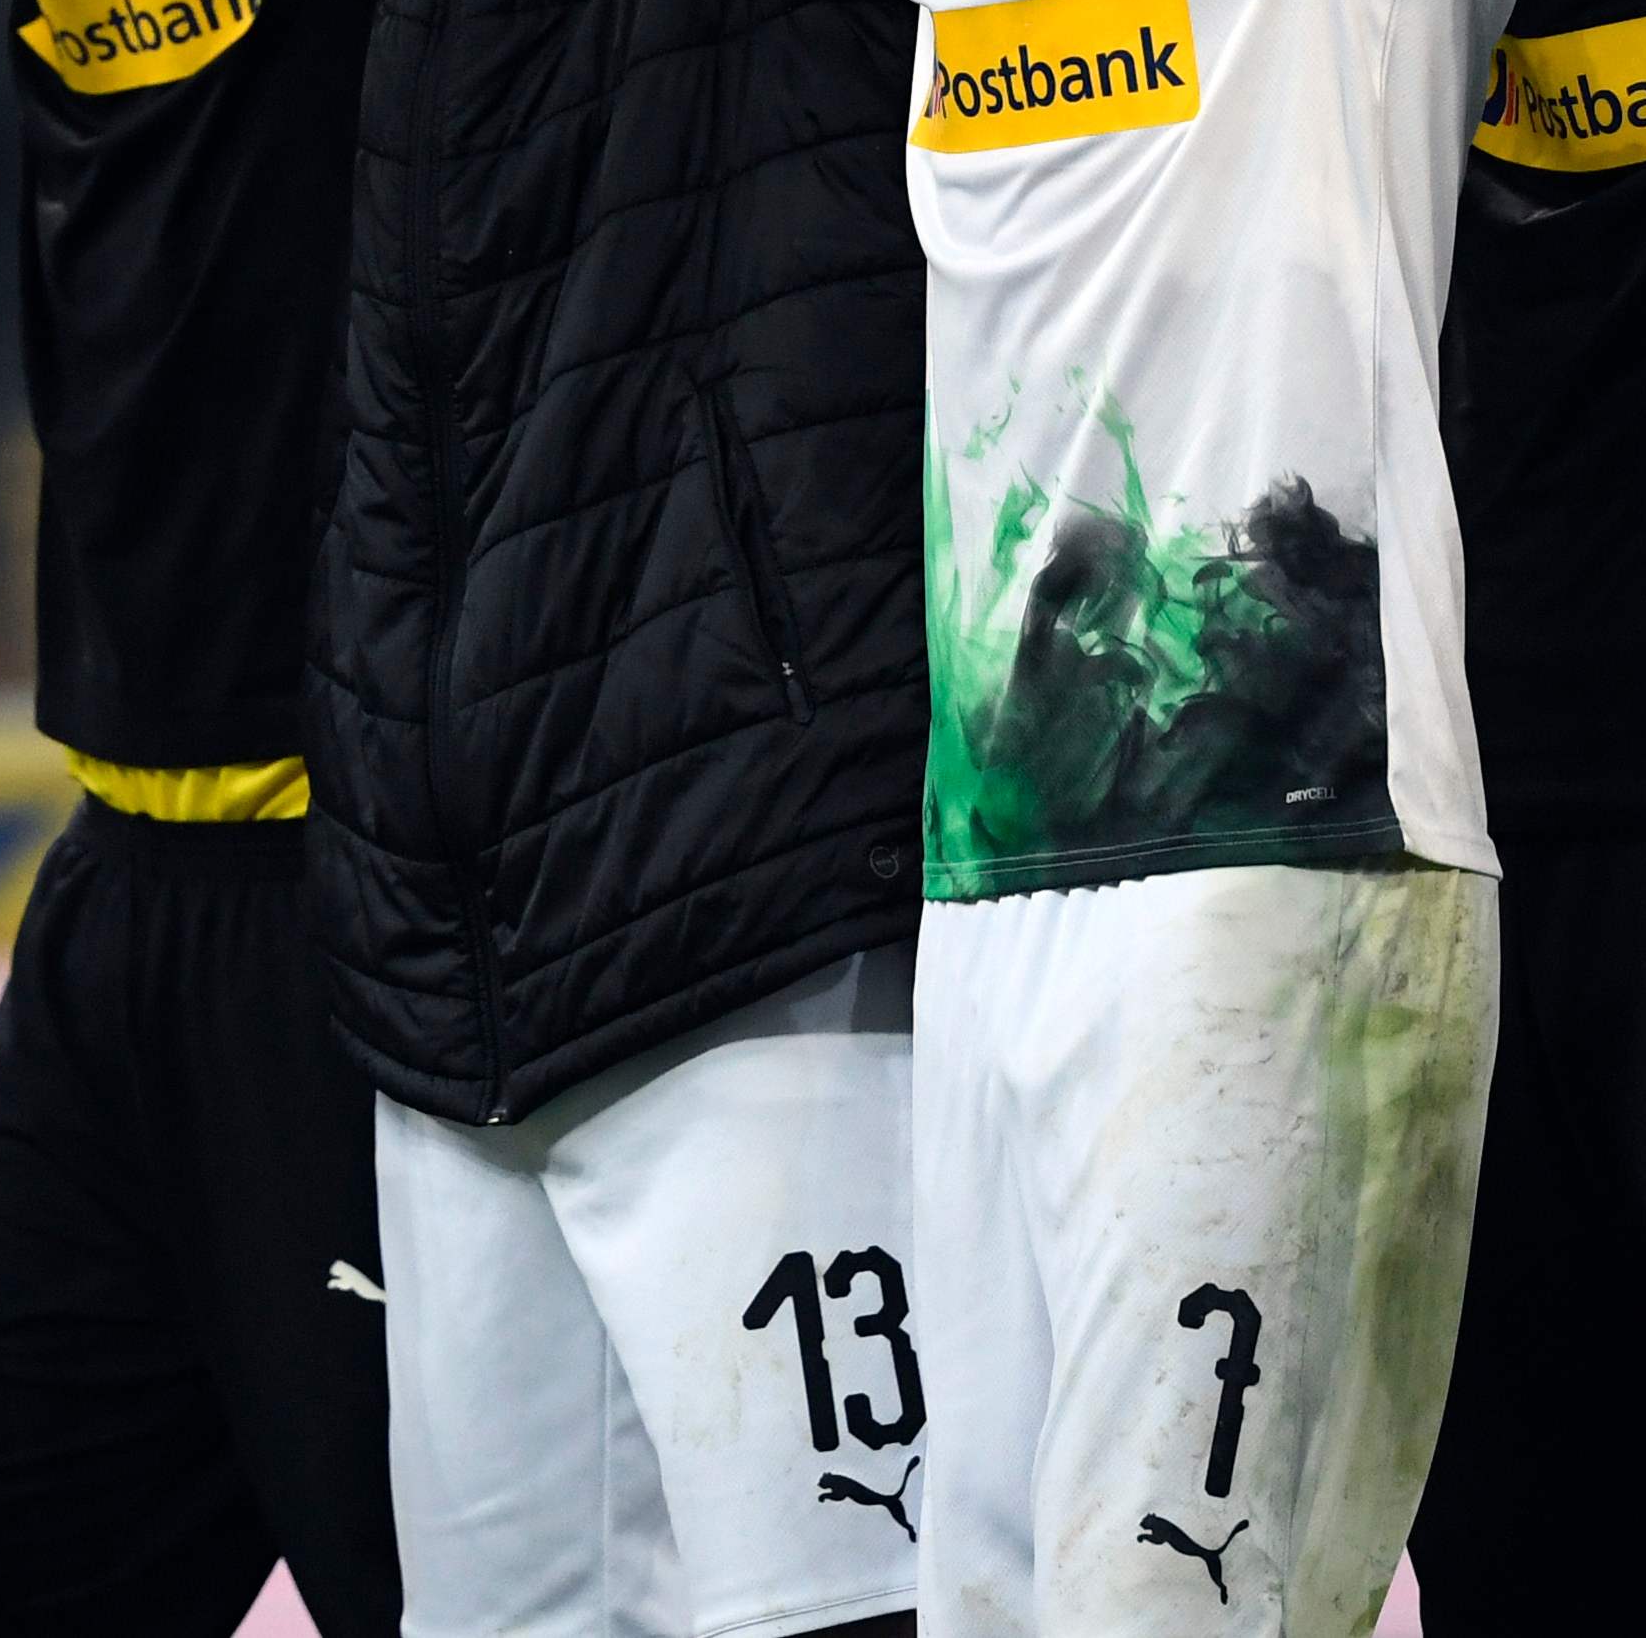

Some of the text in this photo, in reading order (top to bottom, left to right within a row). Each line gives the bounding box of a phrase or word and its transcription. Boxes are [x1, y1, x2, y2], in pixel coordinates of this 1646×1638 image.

[937, 26, 1186, 119] Postbank
[1285, 786, 1338, 804] DRYCELL
[742, 1245, 927, 1453] 13
[1178, 1282, 1263, 1499] 7
